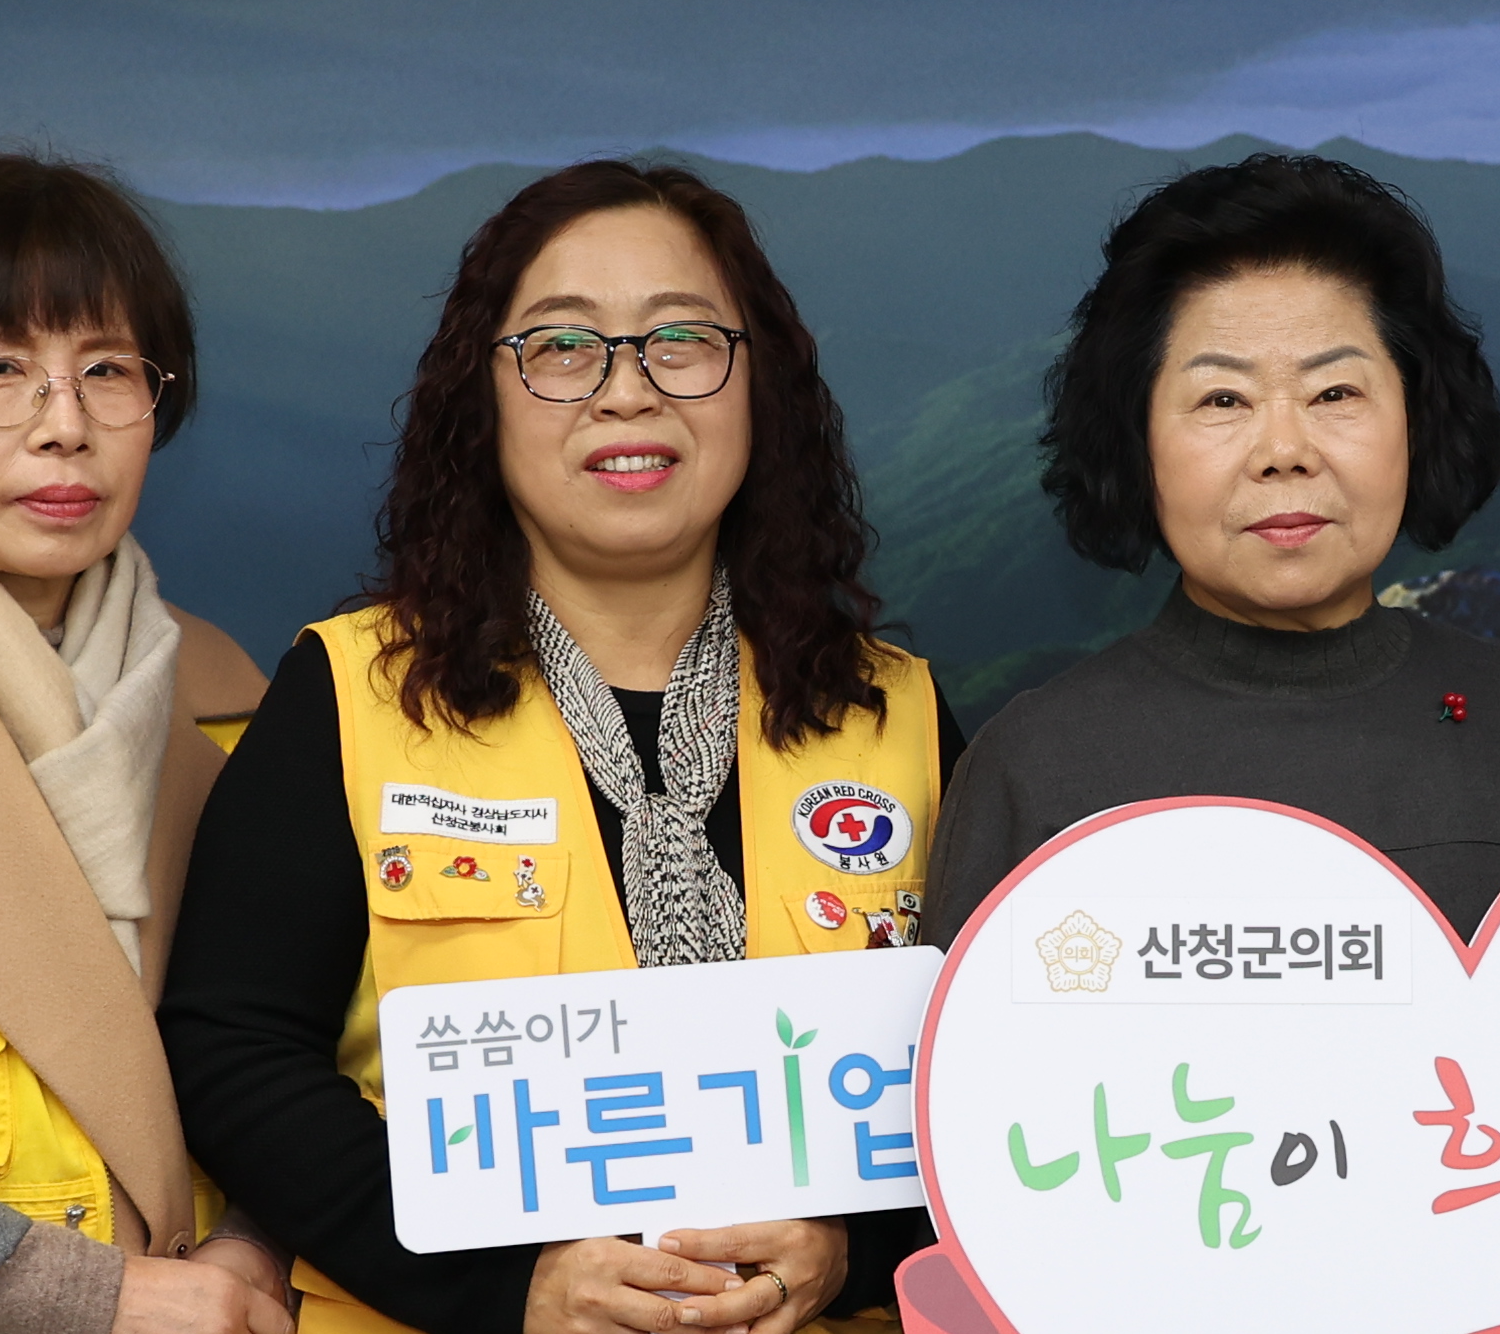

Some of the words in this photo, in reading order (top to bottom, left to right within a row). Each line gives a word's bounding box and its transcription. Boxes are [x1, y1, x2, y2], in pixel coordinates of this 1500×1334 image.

[391, 793, 467, 815] 대한적십자사
[471, 806, 548, 821] 경상남도지사
[797, 785, 834, 819] KOREAN
[832, 785, 856, 798] RED
[858, 788, 896, 814] CROSS
[839, 851, 890, 870] 봉사원
[1062, 946, 1094, 964] 의회
[1136, 923, 1384, 981] 산청군의회
[415, 999, 628, 1071] 씀씀이가
[426, 1044, 920, 1213] 바른기업
[1007, 1062, 1349, 1250] 나눔이
